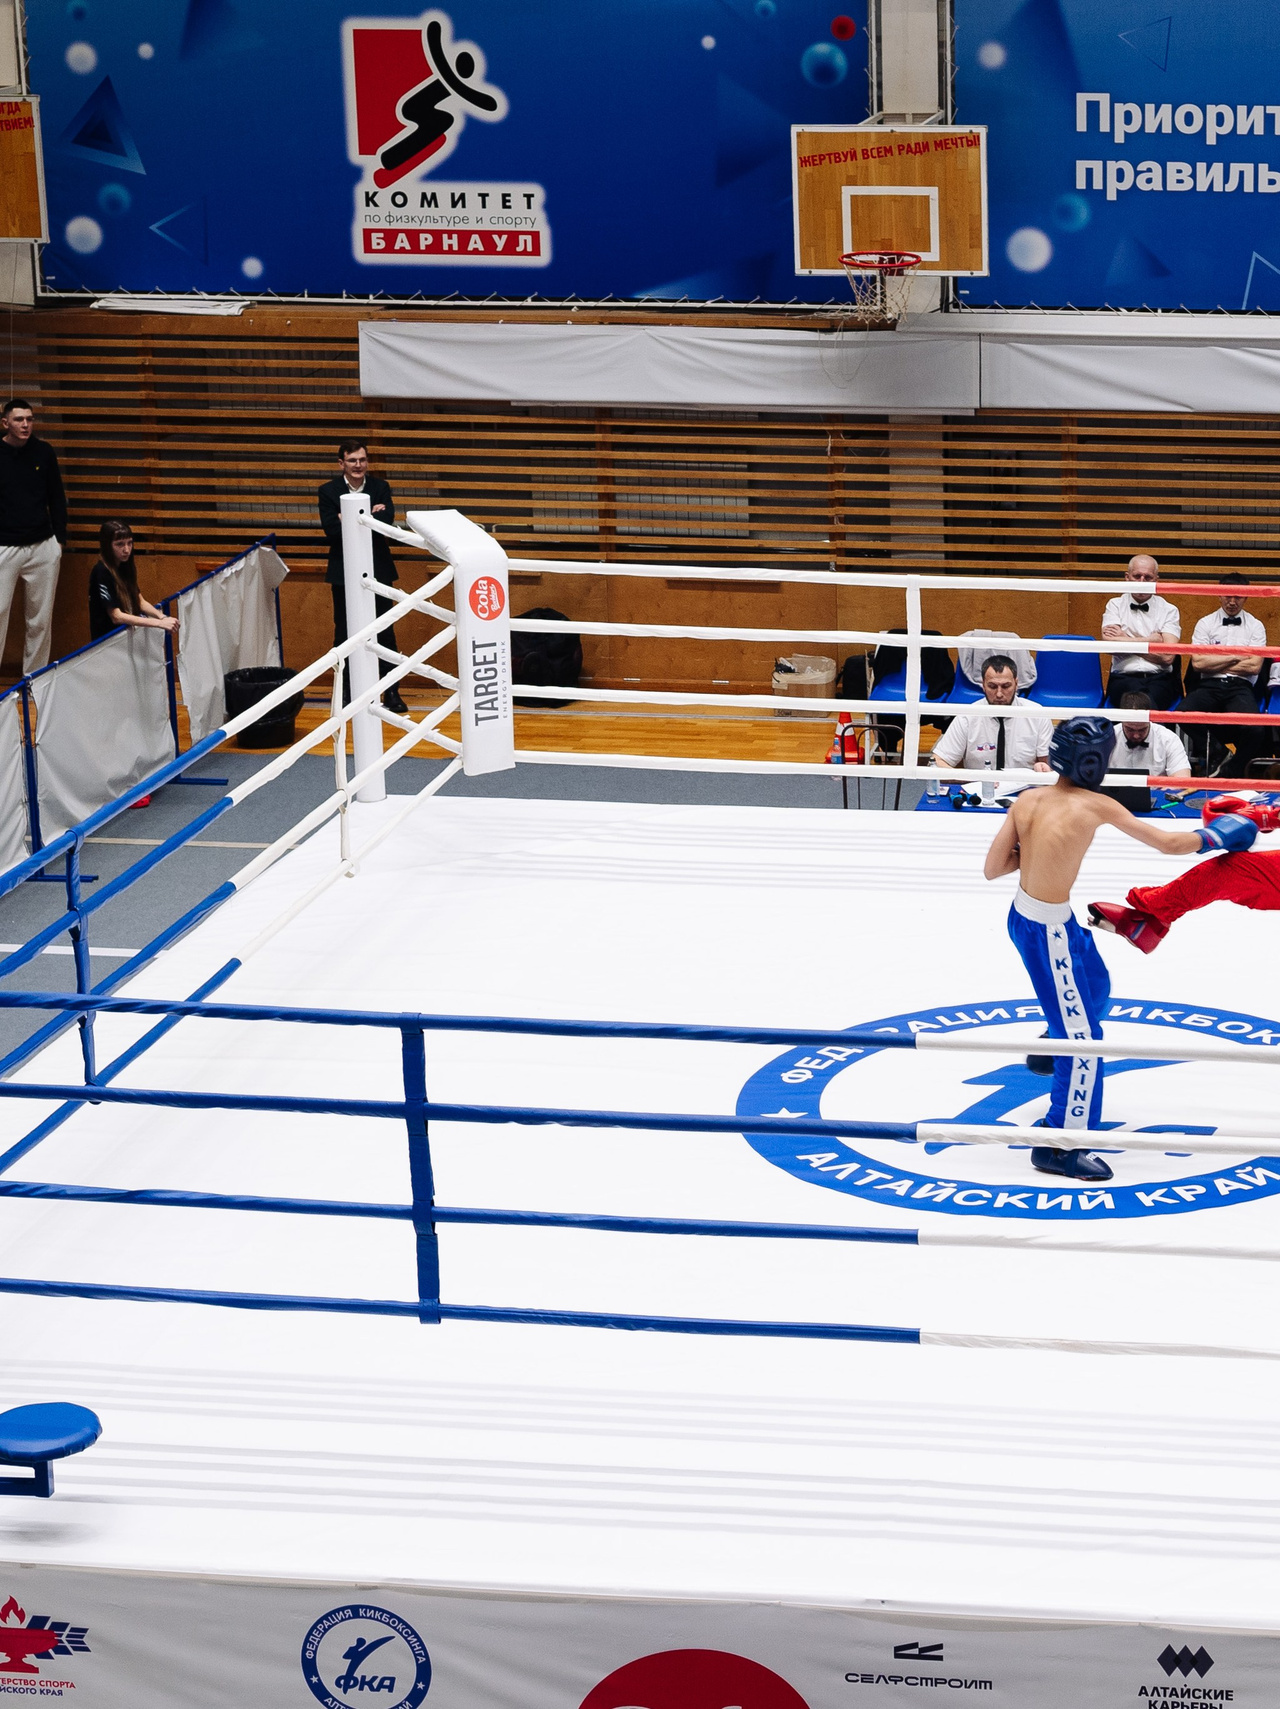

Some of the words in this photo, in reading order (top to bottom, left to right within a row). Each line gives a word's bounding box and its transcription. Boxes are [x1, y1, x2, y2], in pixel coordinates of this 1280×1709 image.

[799, 147, 858, 168] ЖЕРТВУЙ
[861, 144, 894, 161] ВСЕМ
[898, 141, 930, 156] РАДИ
[934, 135, 981, 151] МЕЧТЫ!
[364, 191, 535, 210] КОМИТЕТ
[364, 214, 382, 224] по
[384, 211, 470, 226] физкультуре
[476, 217, 483, 225] и
[489, 217, 537, 228] спорту
[370, 232, 533, 252] БАРНАУЛ
[477, 579, 489, 619] Cola
[472, 640, 499, 727] TARGET
[1055, 955, 1081, 1018] KICK
[795, 1152, 1115, 1211] АЛТАЙСКИЙ
[305, 1608, 353, 1660] ФЕДЕРАЦИЯ
[359, 1608, 426, 1664] КИКБОКСИНГА
[39, 1679, 76, 1689] СПОРТА
[40, 1688, 63, 1696] КРАЯ
[1138, 1684, 1234, 1701] АЛТАЙСКИЕ
